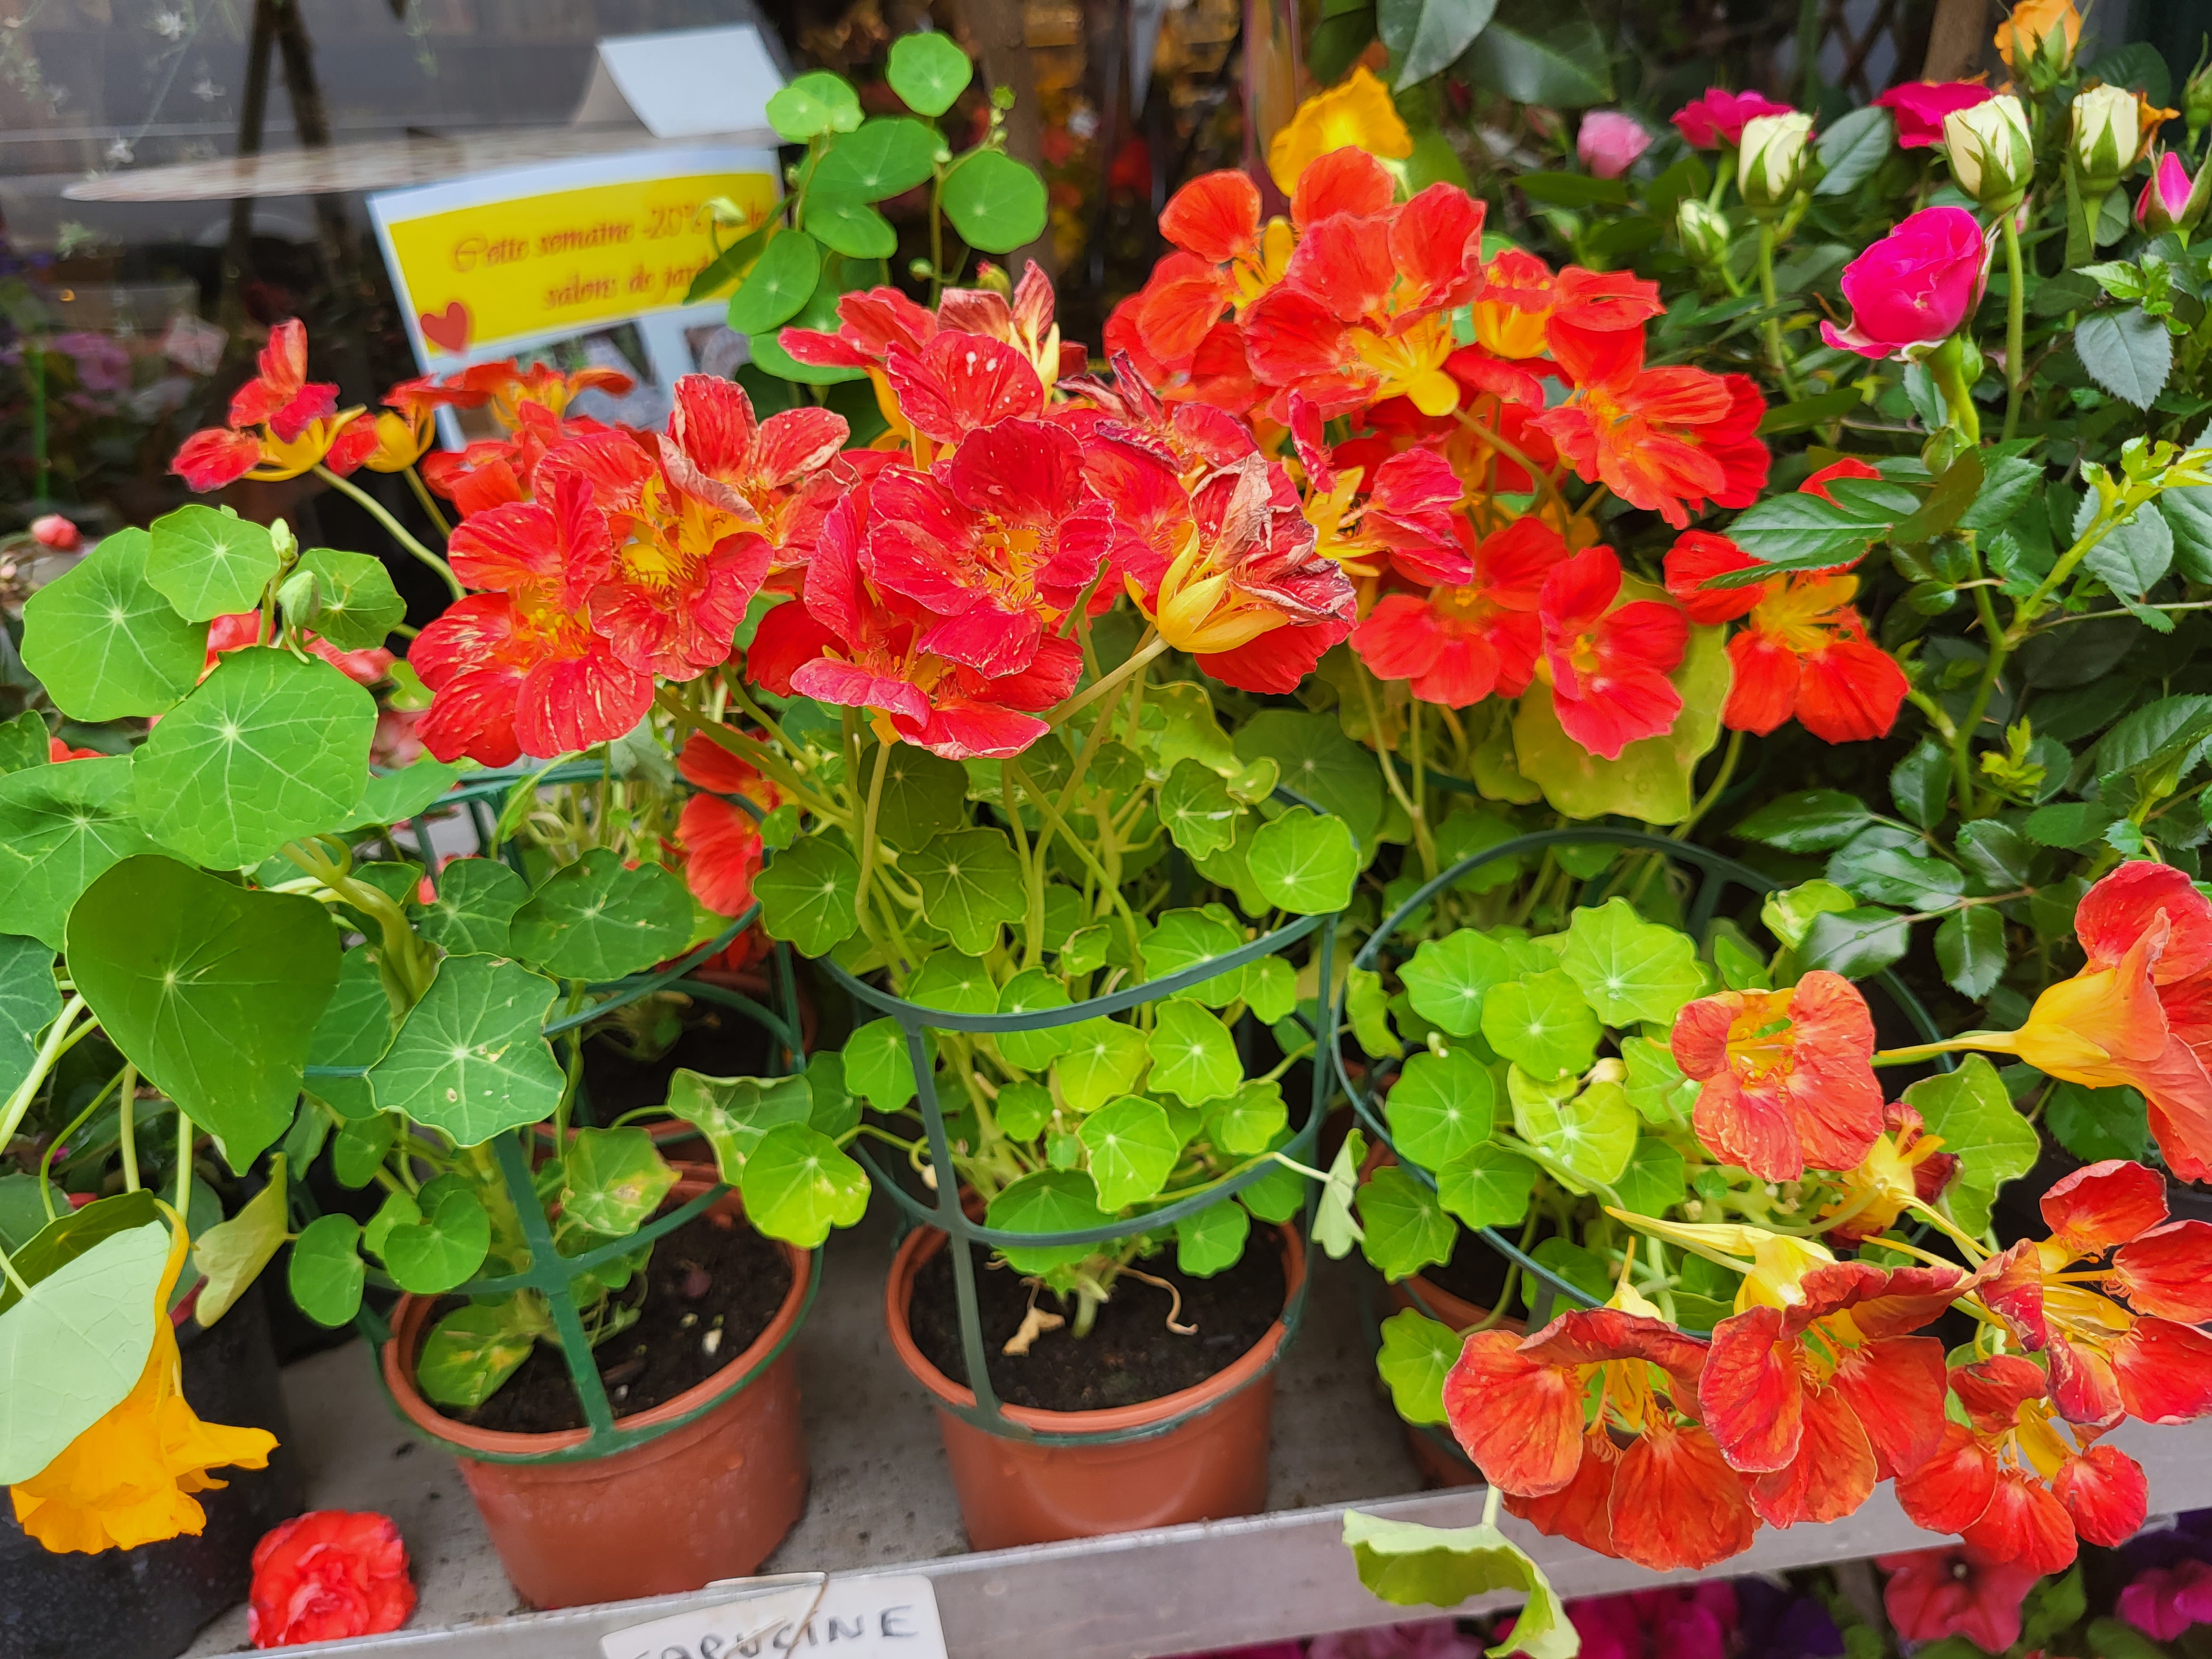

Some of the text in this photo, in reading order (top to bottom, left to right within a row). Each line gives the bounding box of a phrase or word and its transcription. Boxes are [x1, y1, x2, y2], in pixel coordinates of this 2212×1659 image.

[454, 236, 529, 273] Cette
[536, 222, 635, 258] semaine
[544, 273, 618, 311] salons
[628, 263, 653, 294] de
[634, 1605, 919, 1659] PUCINE
